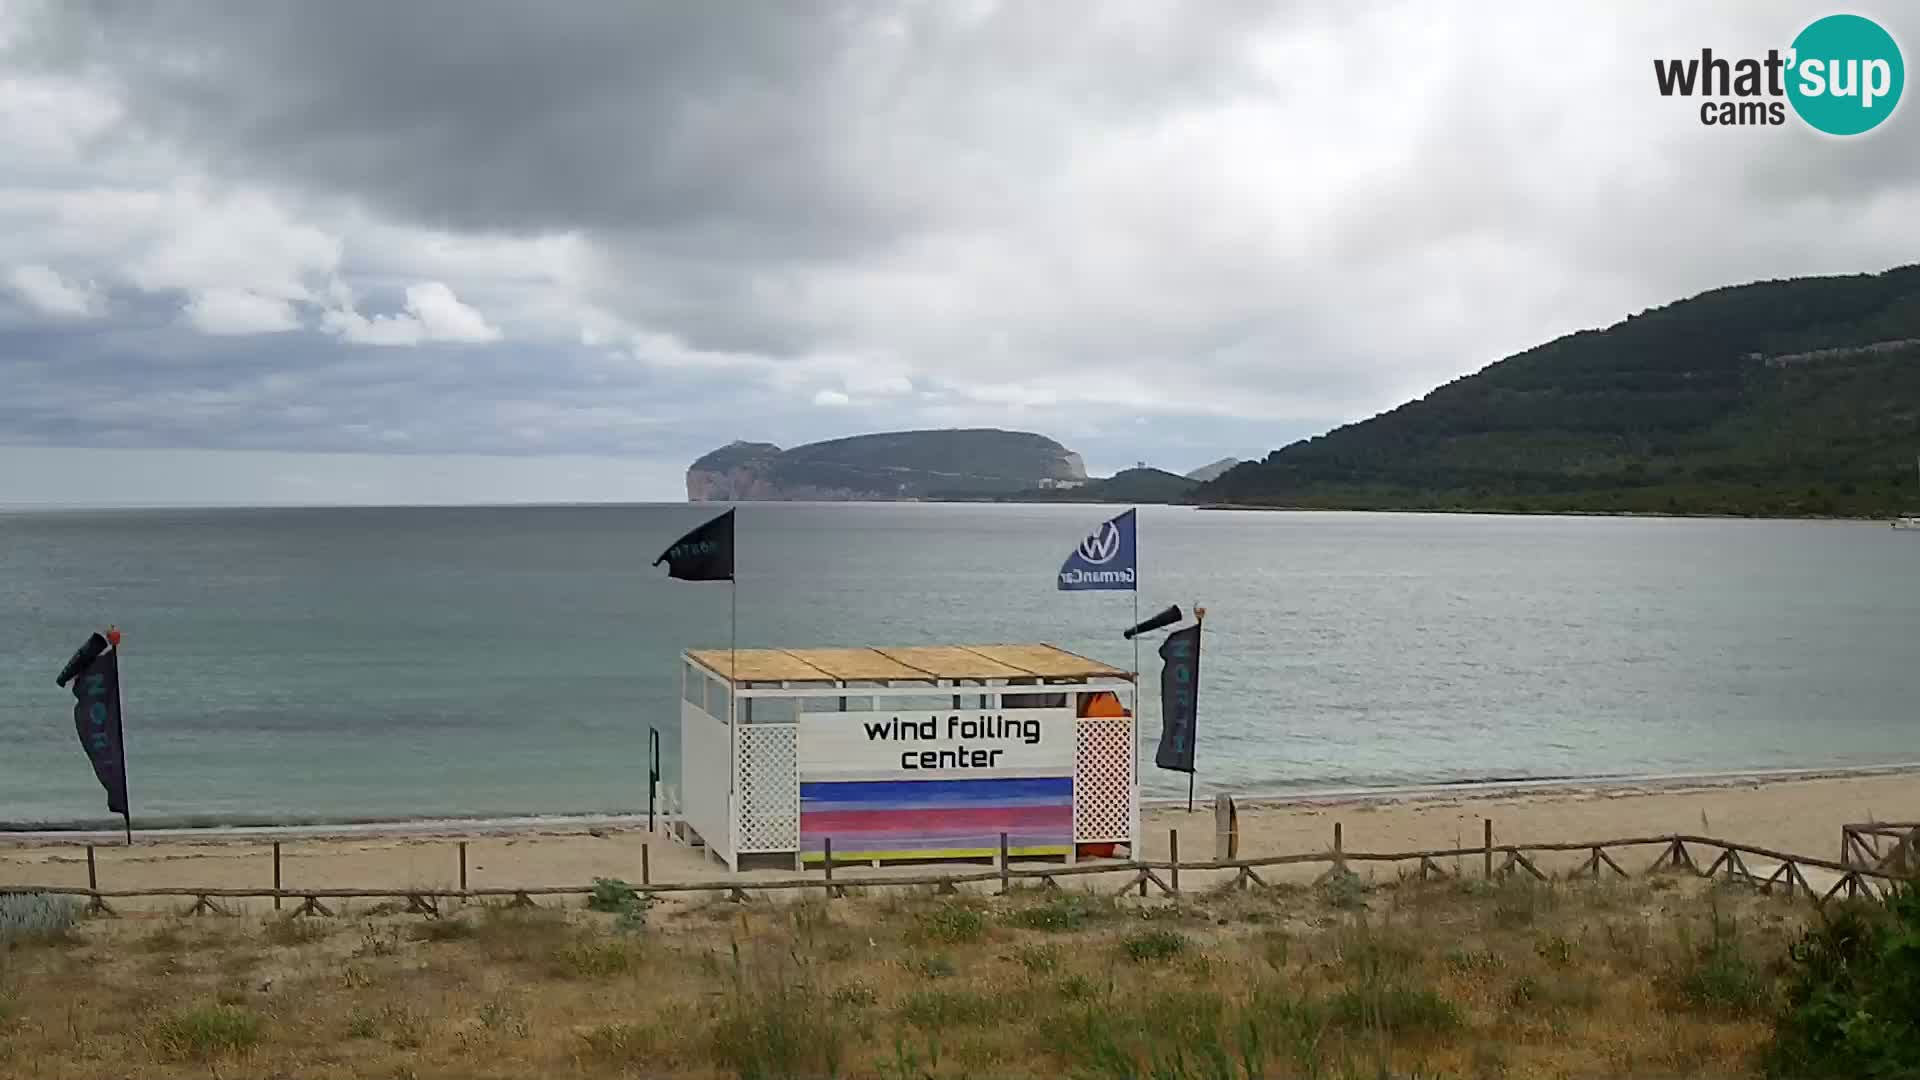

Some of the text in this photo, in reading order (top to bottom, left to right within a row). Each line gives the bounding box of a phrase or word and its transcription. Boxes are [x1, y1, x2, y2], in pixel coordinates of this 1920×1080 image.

[864, 714, 1041, 744] wind foiling
[901, 745, 1004, 770] center
